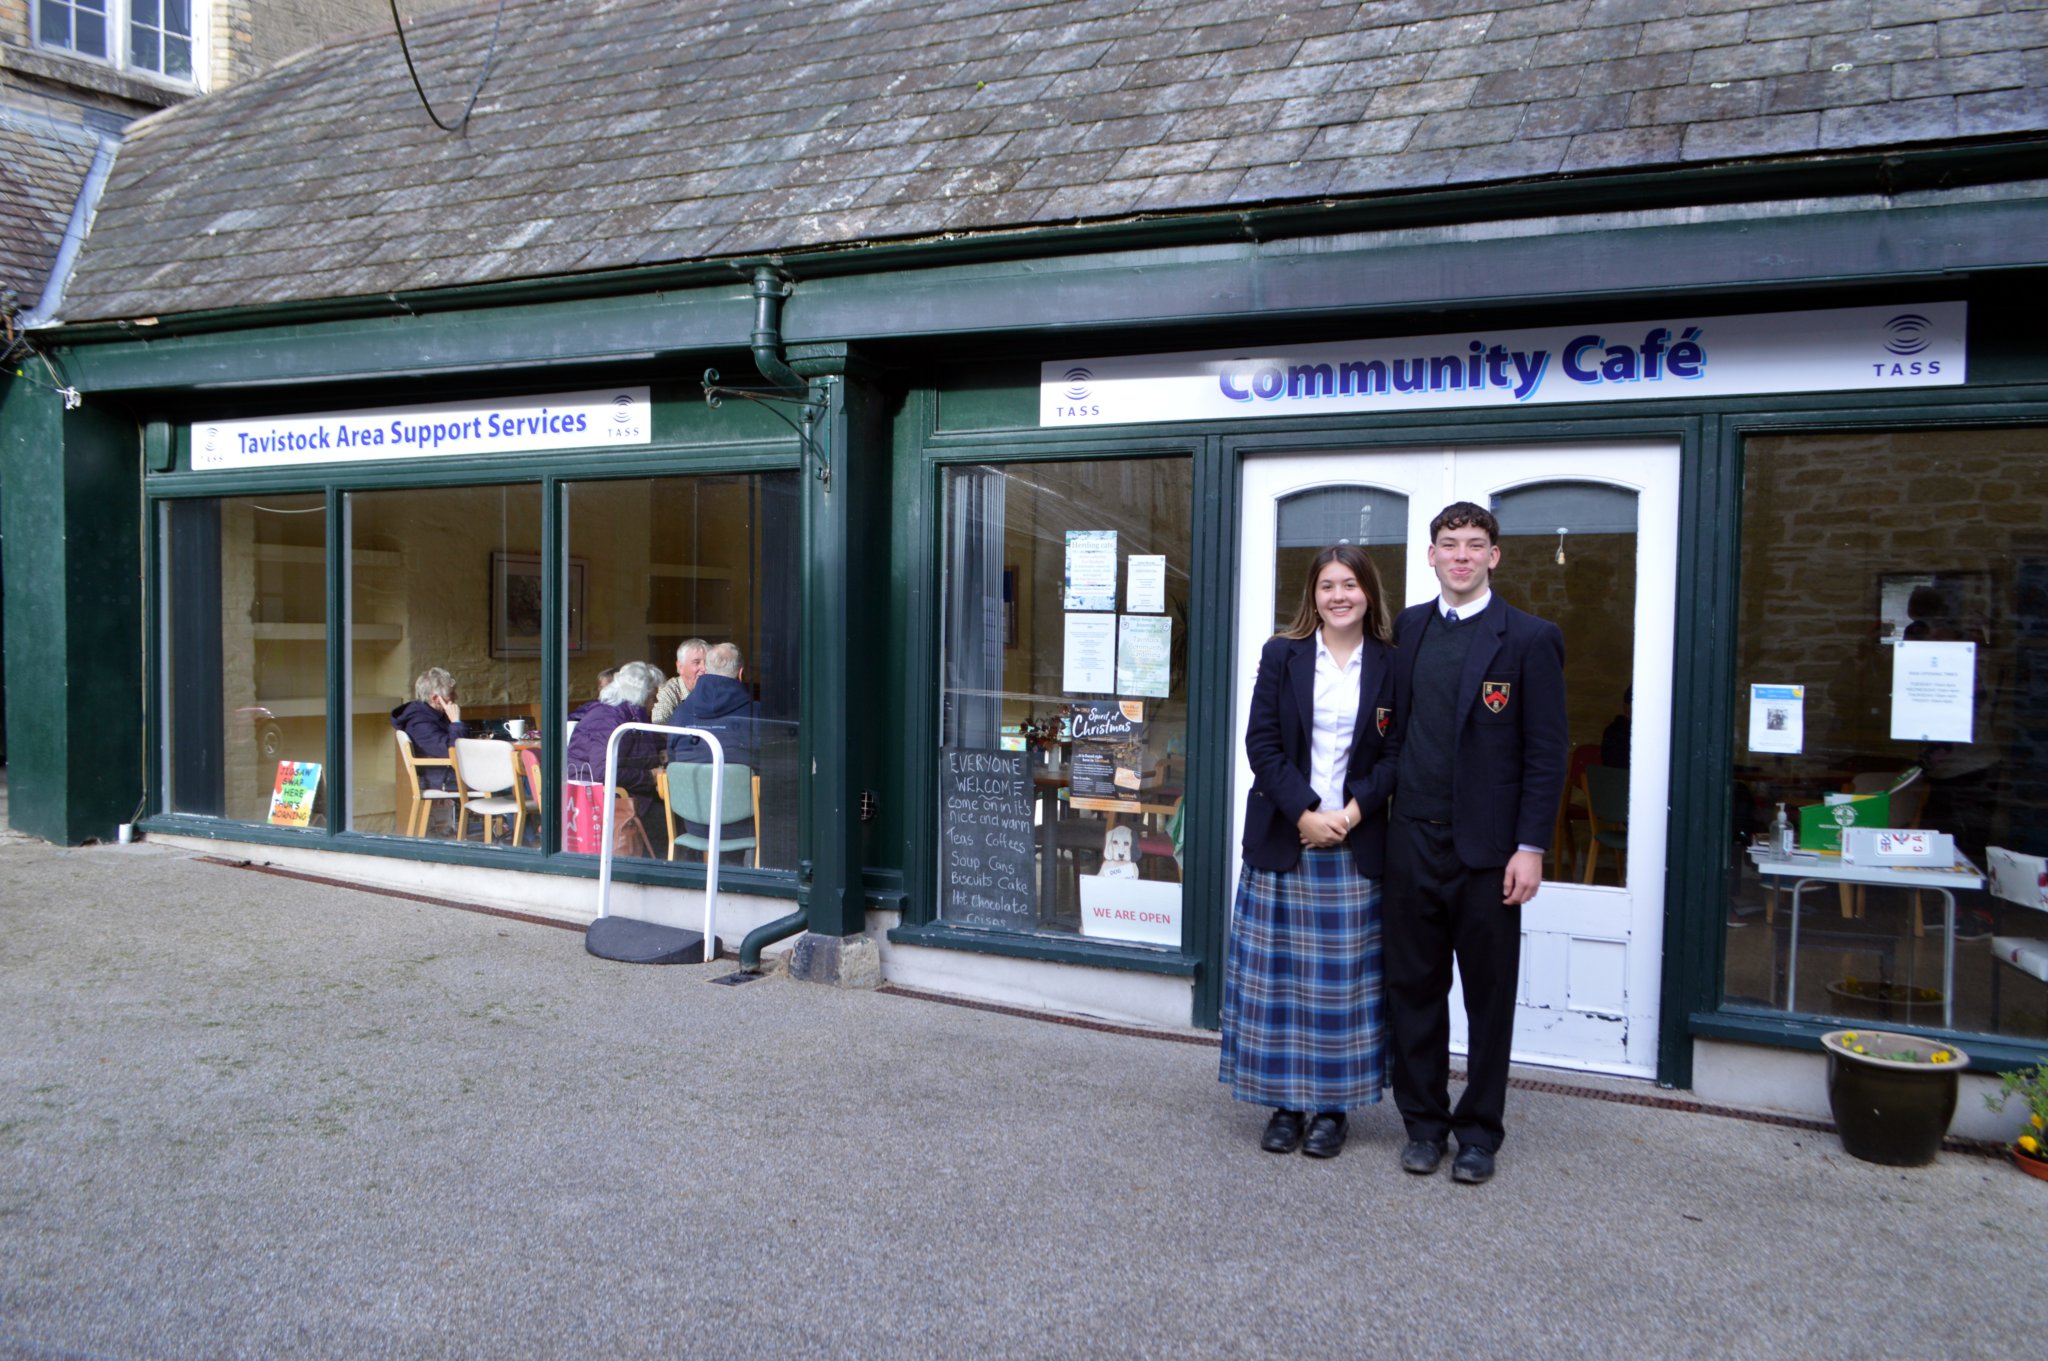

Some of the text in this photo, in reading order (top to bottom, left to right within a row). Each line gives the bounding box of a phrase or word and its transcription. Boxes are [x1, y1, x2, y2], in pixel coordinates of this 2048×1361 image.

[1219, 326, 1707, 402] Community Café
[1872, 360, 1941, 377] TASS
[1056, 405, 1100, 417] TASS
[237, 408, 588, 454] Tavistock Area Support Services
[607, 427, 640, 438] TASS
[1072, 713, 1132, 738] Christmas
[1088, 707, 1111, 723] Spirit
[1111, 711, 1120, 722] of
[280, 766, 312, 777] JIGSAW
[949, 752, 1021, 775] EVERYONE
[282, 777, 304, 787] SWAP
[955, 775, 1025, 796] WELCOME
[284, 788, 304, 798] HERE
[983, 800, 998, 812] on
[1000, 802, 1012, 815] in
[949, 810, 1031, 834] nice and warm
[946, 826, 1026, 854] Teas Coffees
[951, 850, 1015, 875] Soup Cans
[951, 871, 1029, 896] Biscuits Cake
[971, 893, 1029, 915] Chocolate
[1093, 907, 1171, 925] WE ARE OPEN
